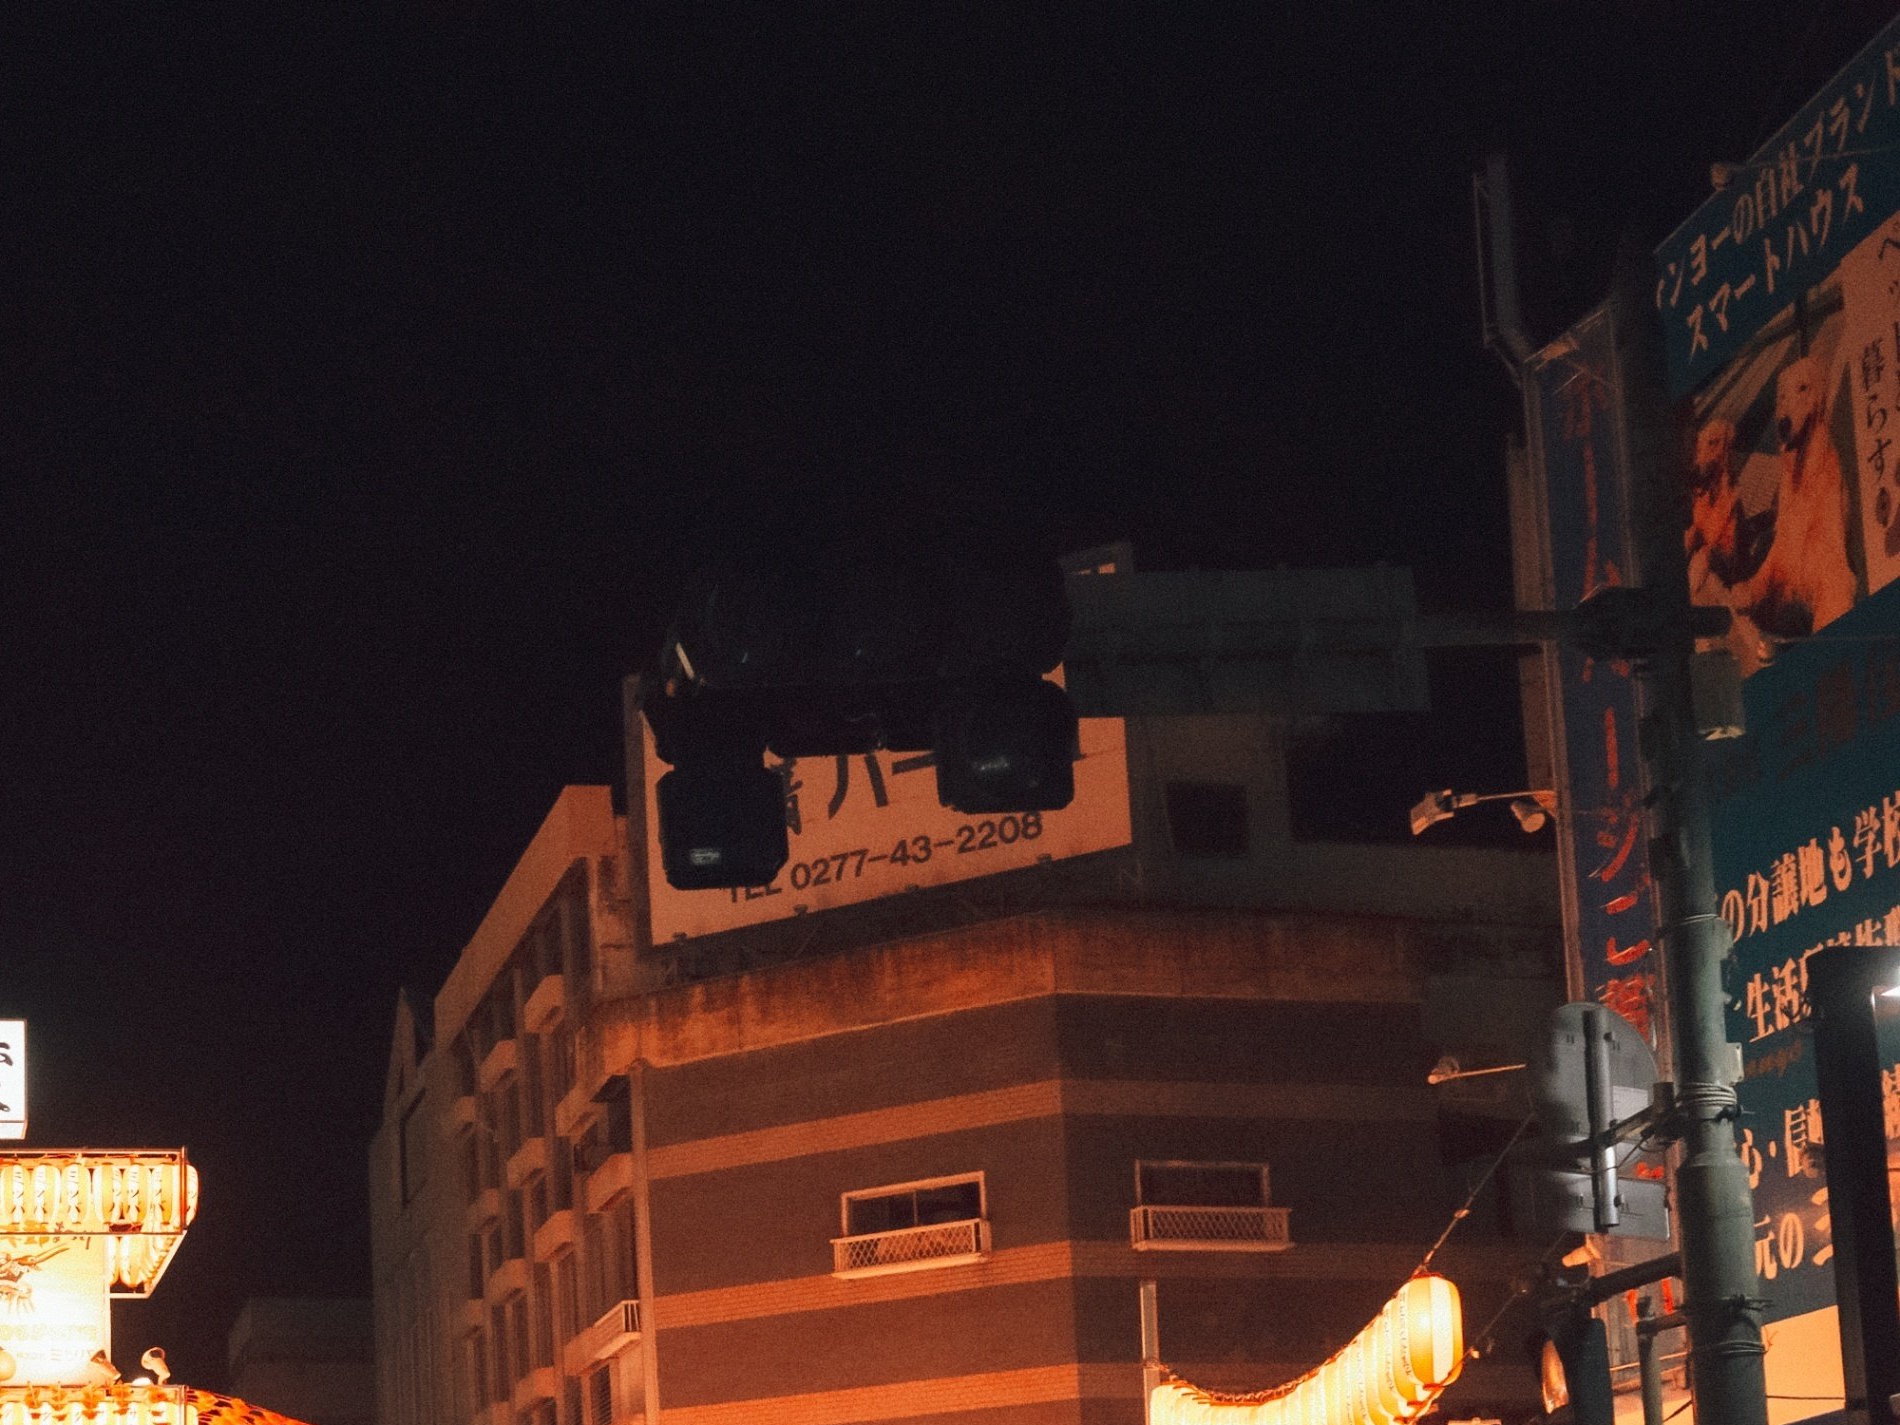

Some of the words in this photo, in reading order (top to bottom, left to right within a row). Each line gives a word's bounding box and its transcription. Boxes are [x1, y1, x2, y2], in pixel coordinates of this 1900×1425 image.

[1687, 162, 1864, 366] スマートハウス
[790, 810, 1044, 890] 0277-43-2208
